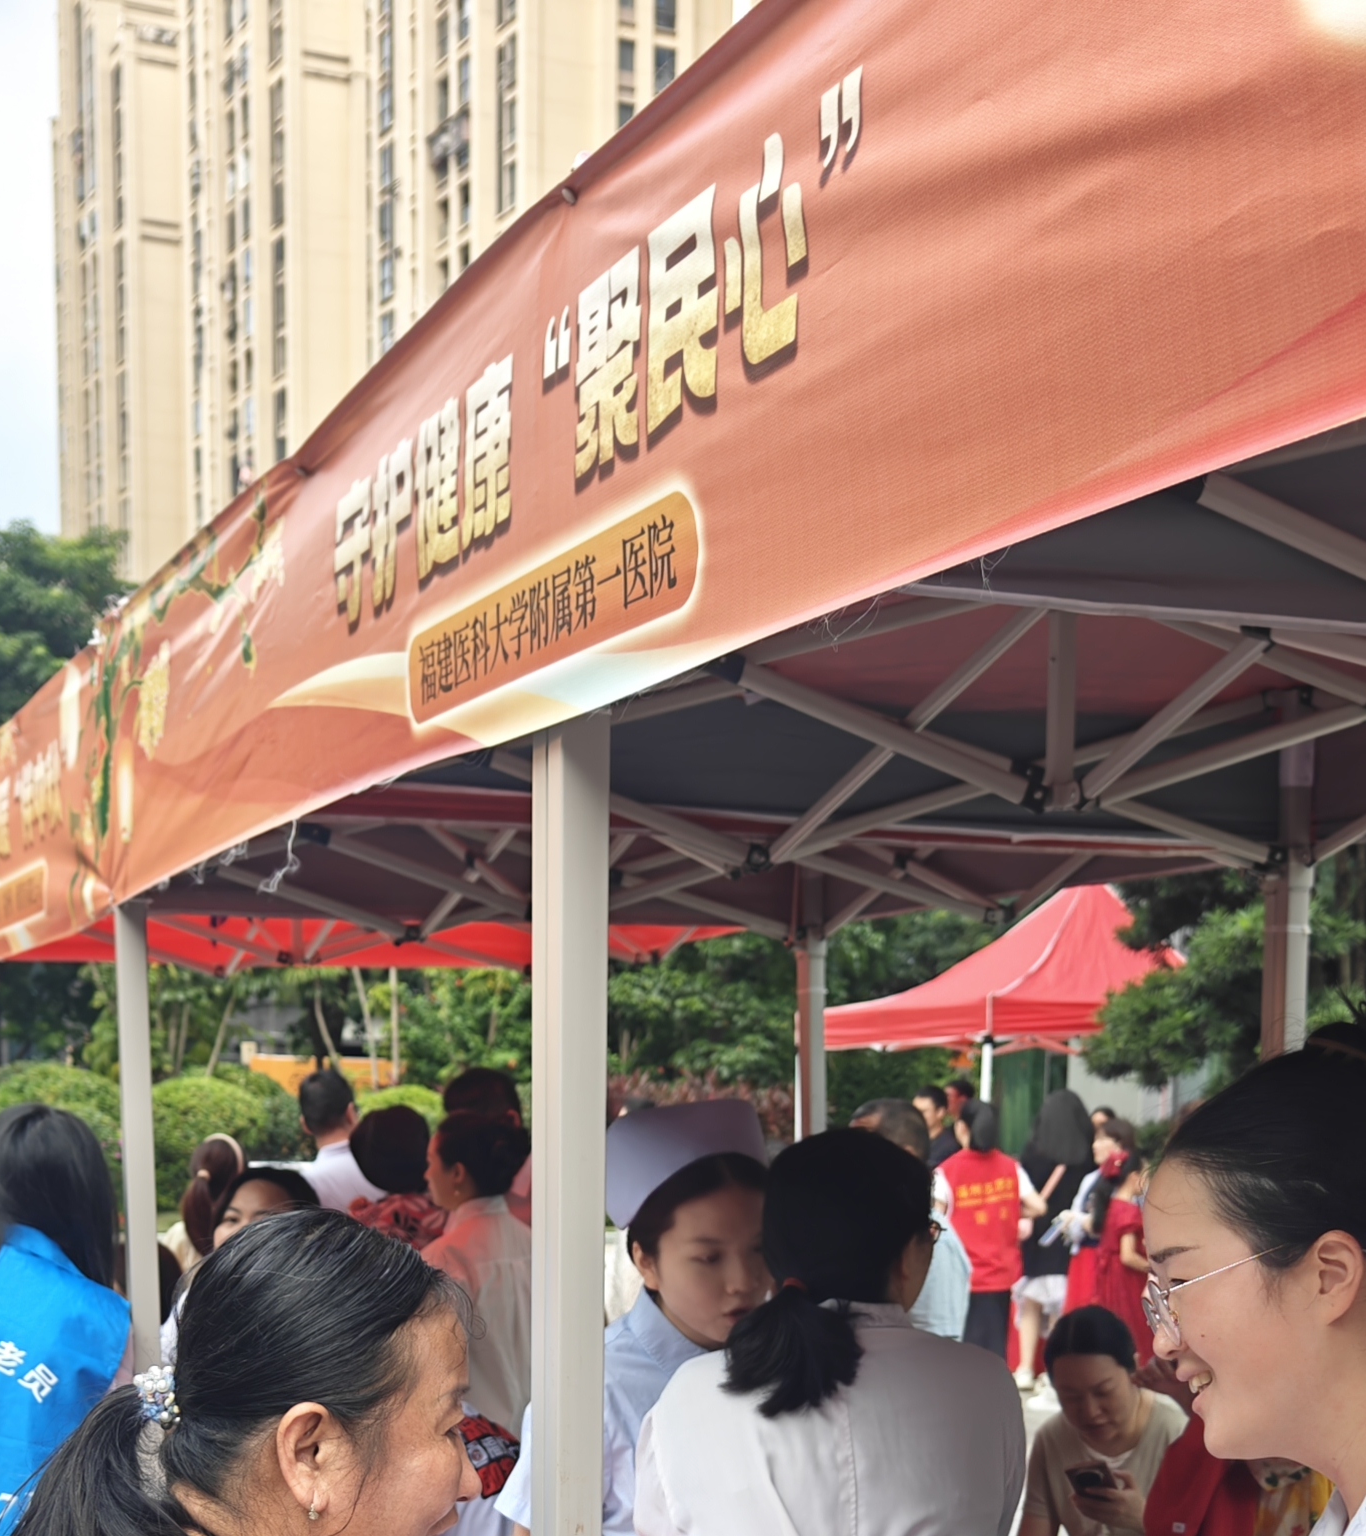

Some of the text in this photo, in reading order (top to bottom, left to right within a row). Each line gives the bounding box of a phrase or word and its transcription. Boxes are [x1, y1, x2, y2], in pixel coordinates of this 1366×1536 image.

[419, 514, 678, 705] 福建医科大学附属第一医院
